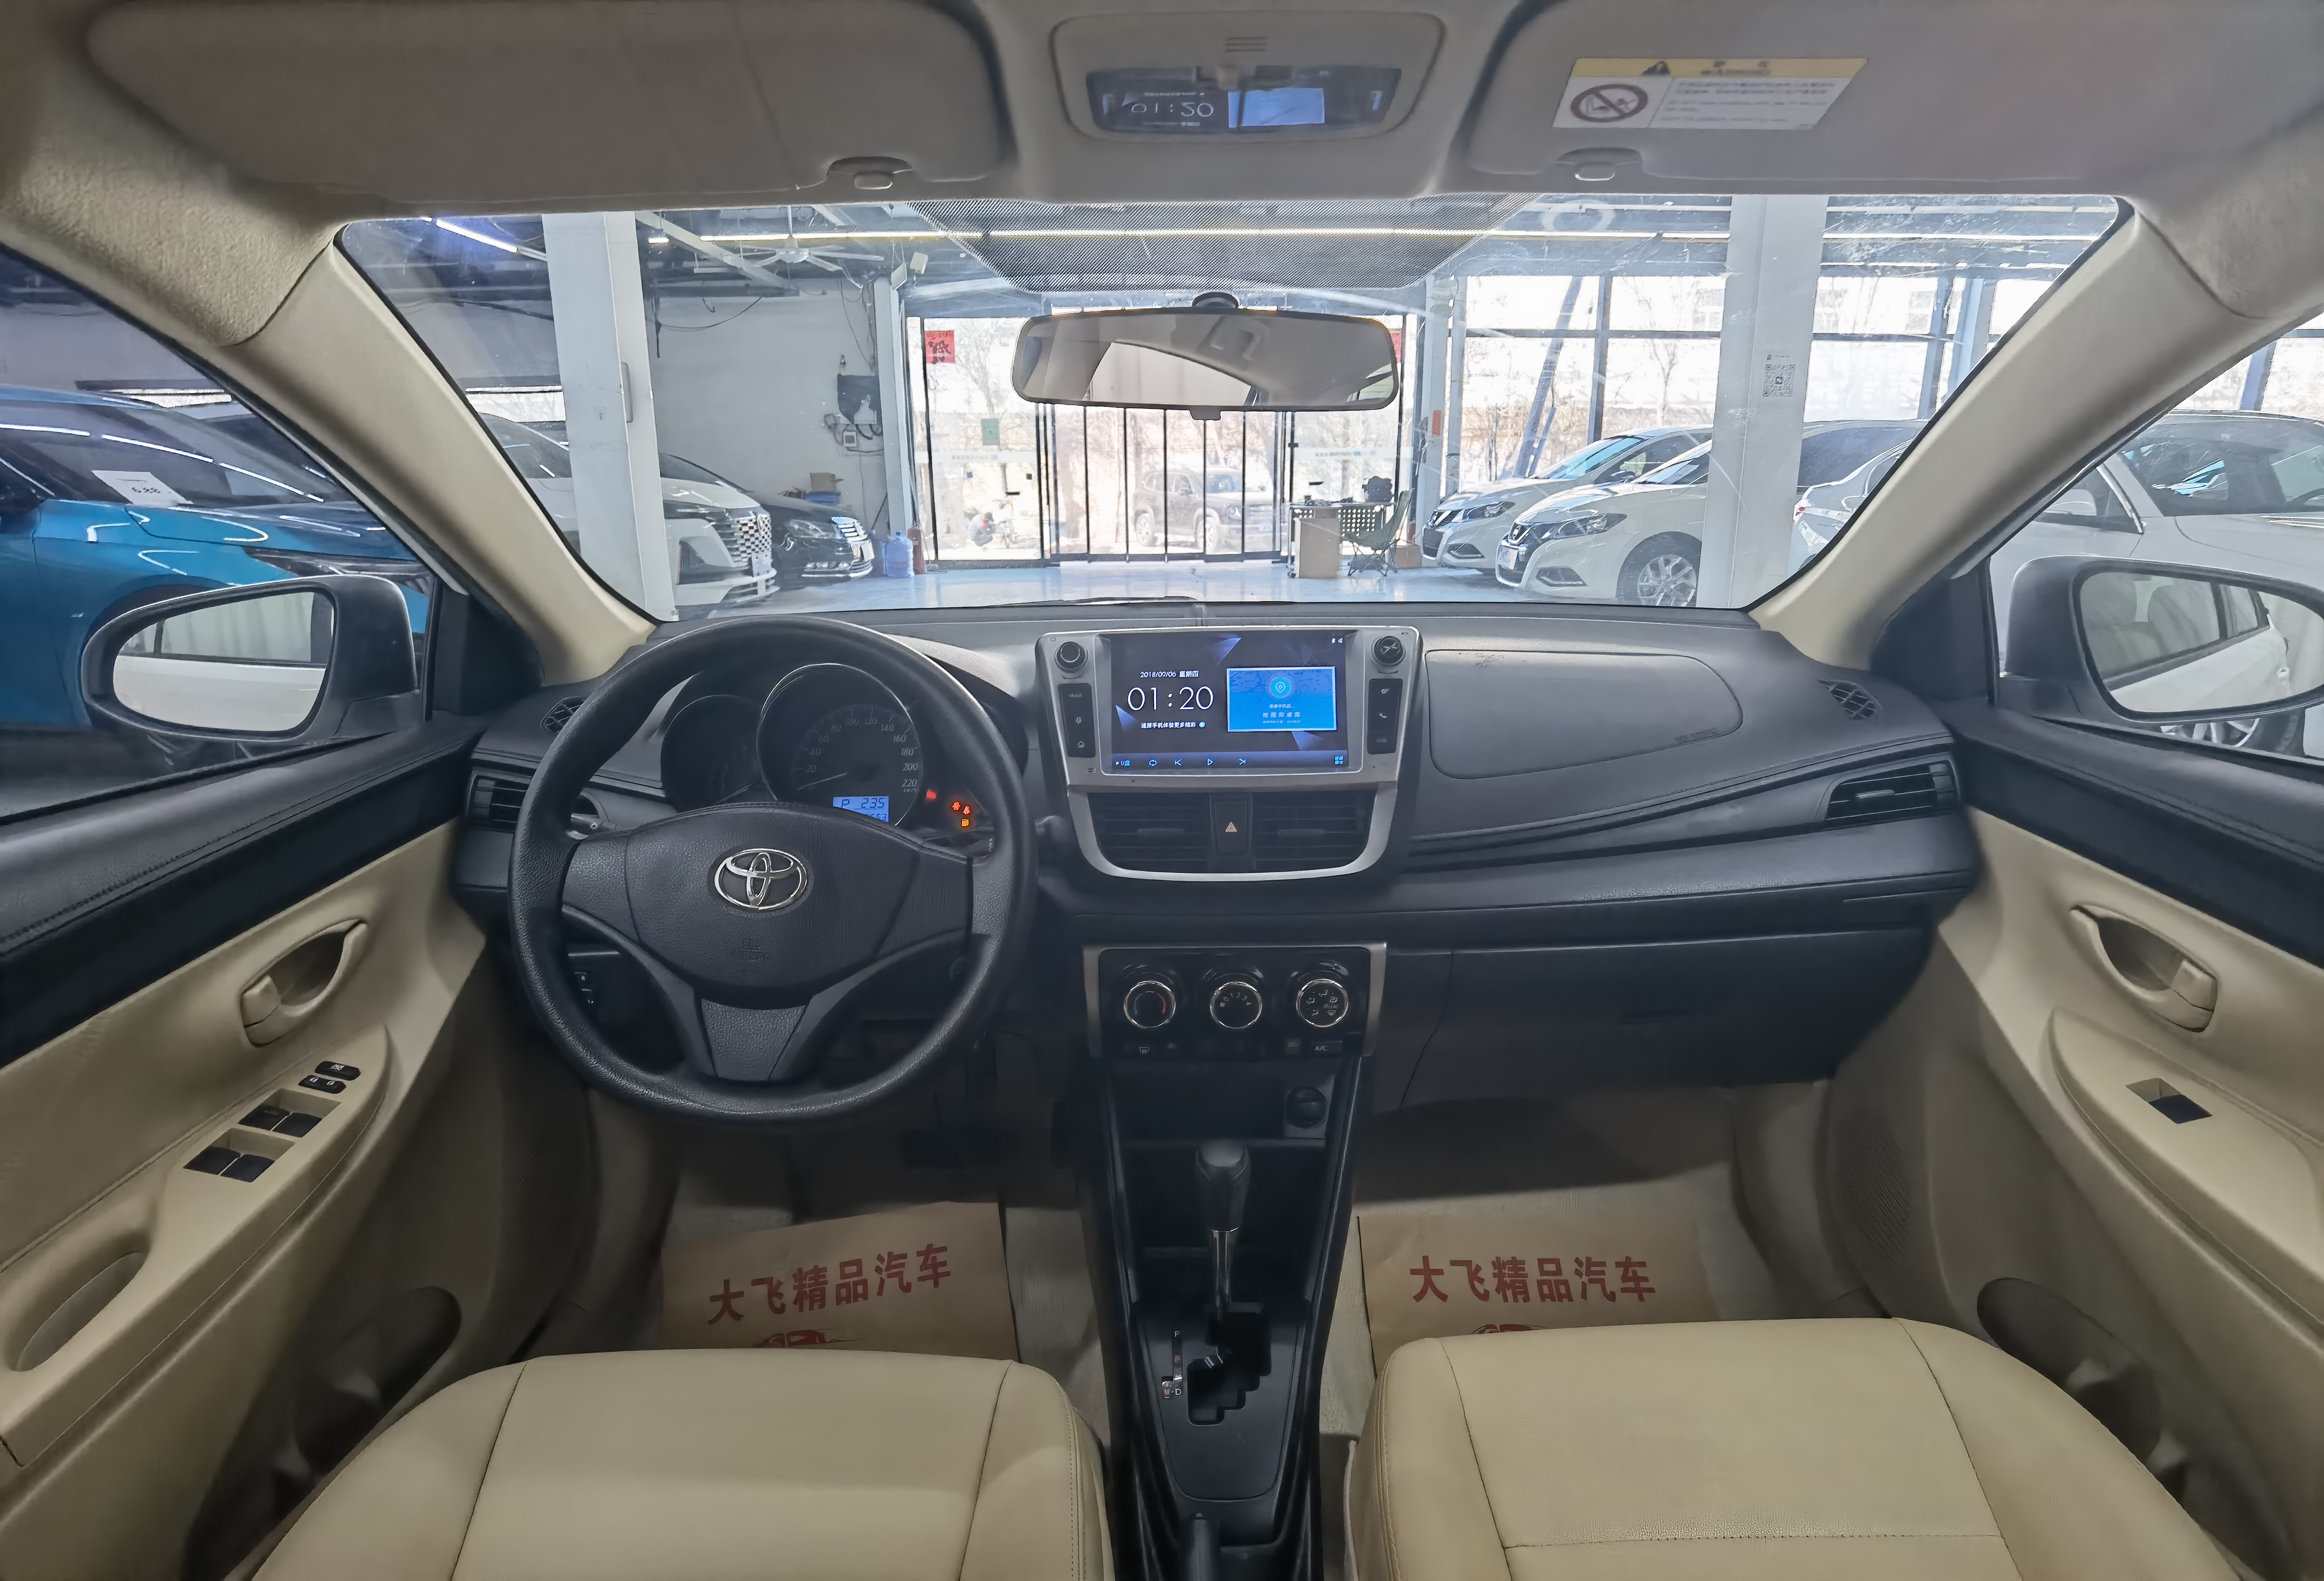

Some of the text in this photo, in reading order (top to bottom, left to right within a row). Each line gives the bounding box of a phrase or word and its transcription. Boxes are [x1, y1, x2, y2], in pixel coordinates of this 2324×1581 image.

[1127, 686, 1214, 711] 01:20
[893, 734, 906, 742] 160
[901, 748, 914, 756] 180
[902, 763, 918, 771] 200
[902, 779, 917, 787] 220
[841, 797, 885, 809] P 235
[707, 1243, 951, 1325] 大飞精品汽车
[1410, 1255, 1656, 1303] 大飞精品汽车
